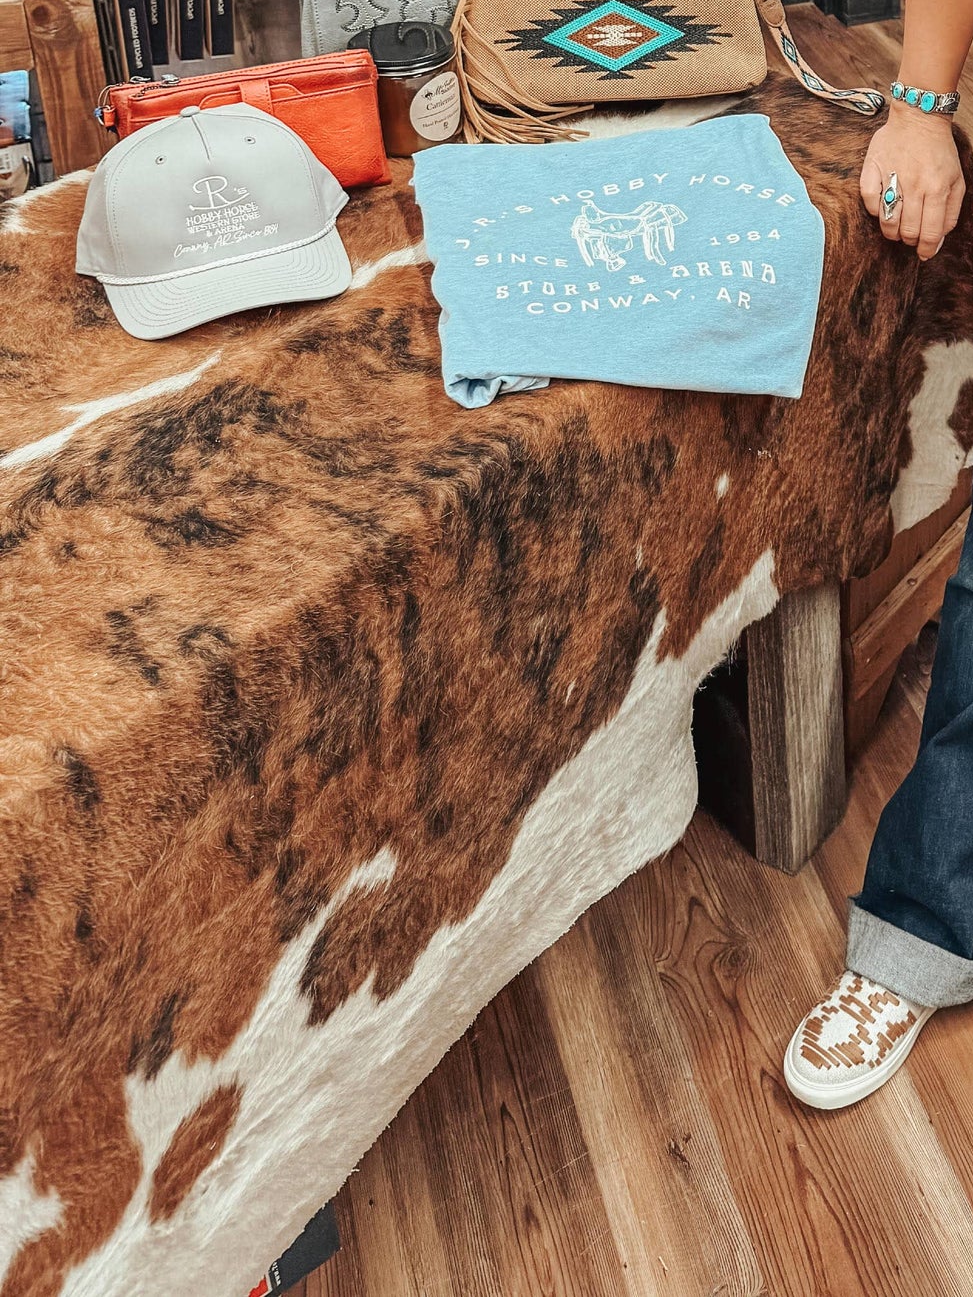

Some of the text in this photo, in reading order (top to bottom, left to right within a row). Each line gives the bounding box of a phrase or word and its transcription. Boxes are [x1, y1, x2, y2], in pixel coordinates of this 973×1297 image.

[550, 172, 669, 205] HOBBY
[689, 173, 796, 207] HORSE
[185, 201, 259, 228] HOBBY HORSE
[187, 211, 261, 235] WESTERN STORE
[214, 223, 246, 236] ARENA
[473, 228, 781, 267] SINCE 1984
[496, 260, 777, 299] STORE & ARENA
[716, 287, 751, 310] AR
